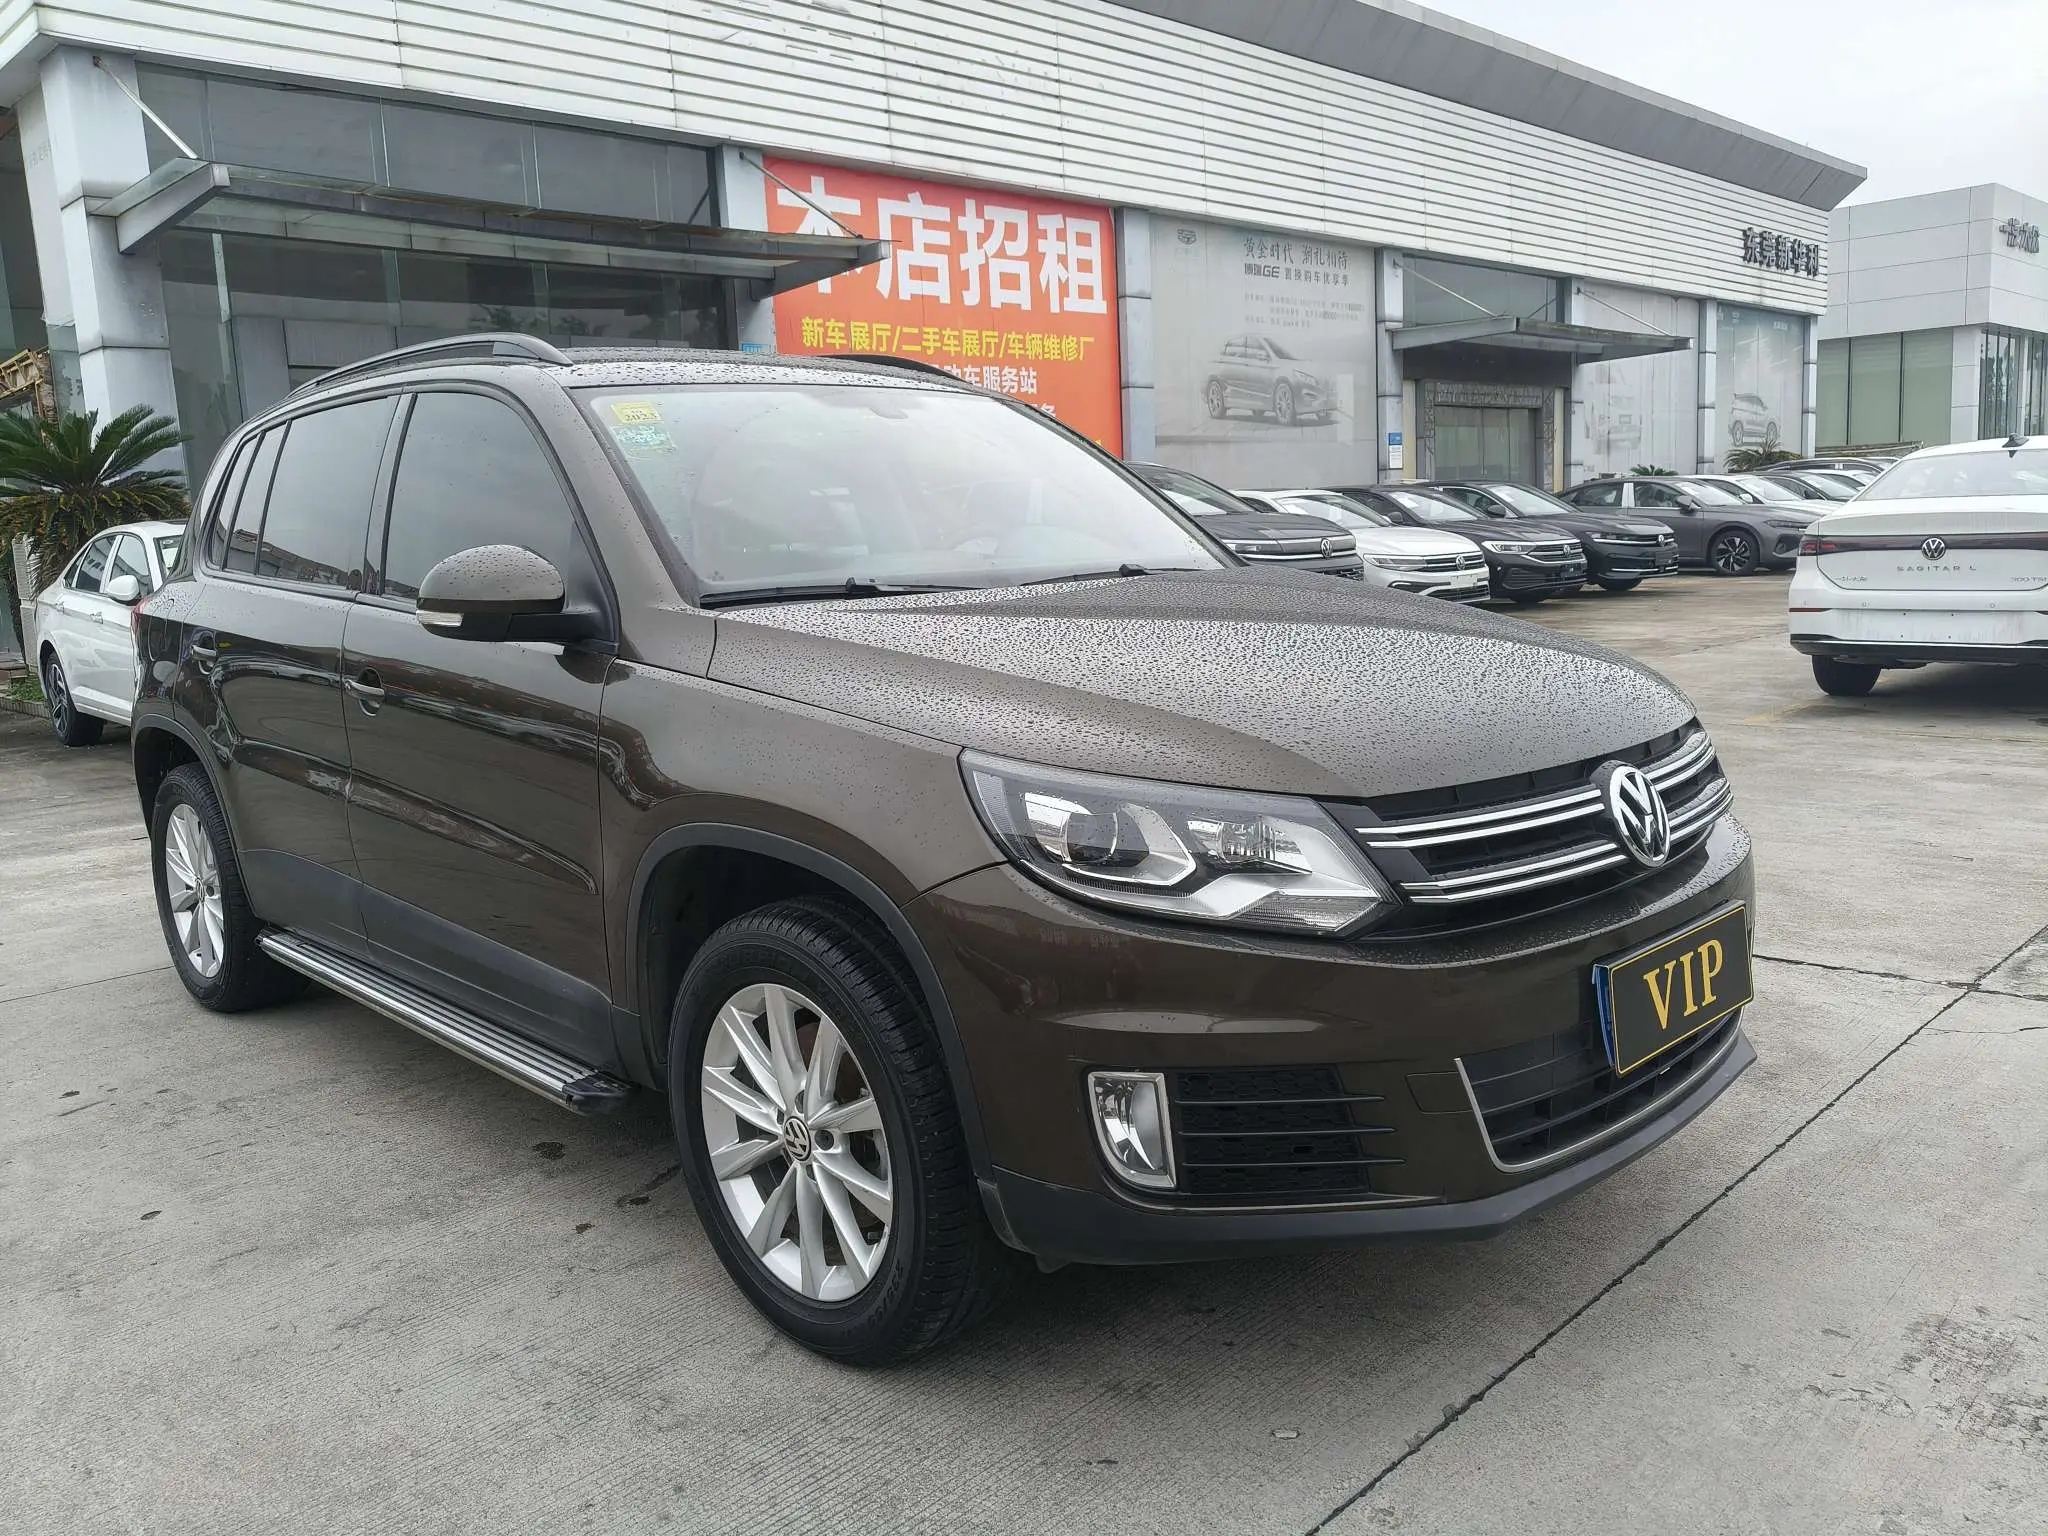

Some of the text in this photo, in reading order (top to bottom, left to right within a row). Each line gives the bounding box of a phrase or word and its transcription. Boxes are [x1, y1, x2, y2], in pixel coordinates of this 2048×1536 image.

[777, 176, 1107, 314] 本店招租
[801, 316, 1095, 361] 新车展厅/二手车展厅/车辆维修厂
[1643, 939, 1723, 1030] VIP
